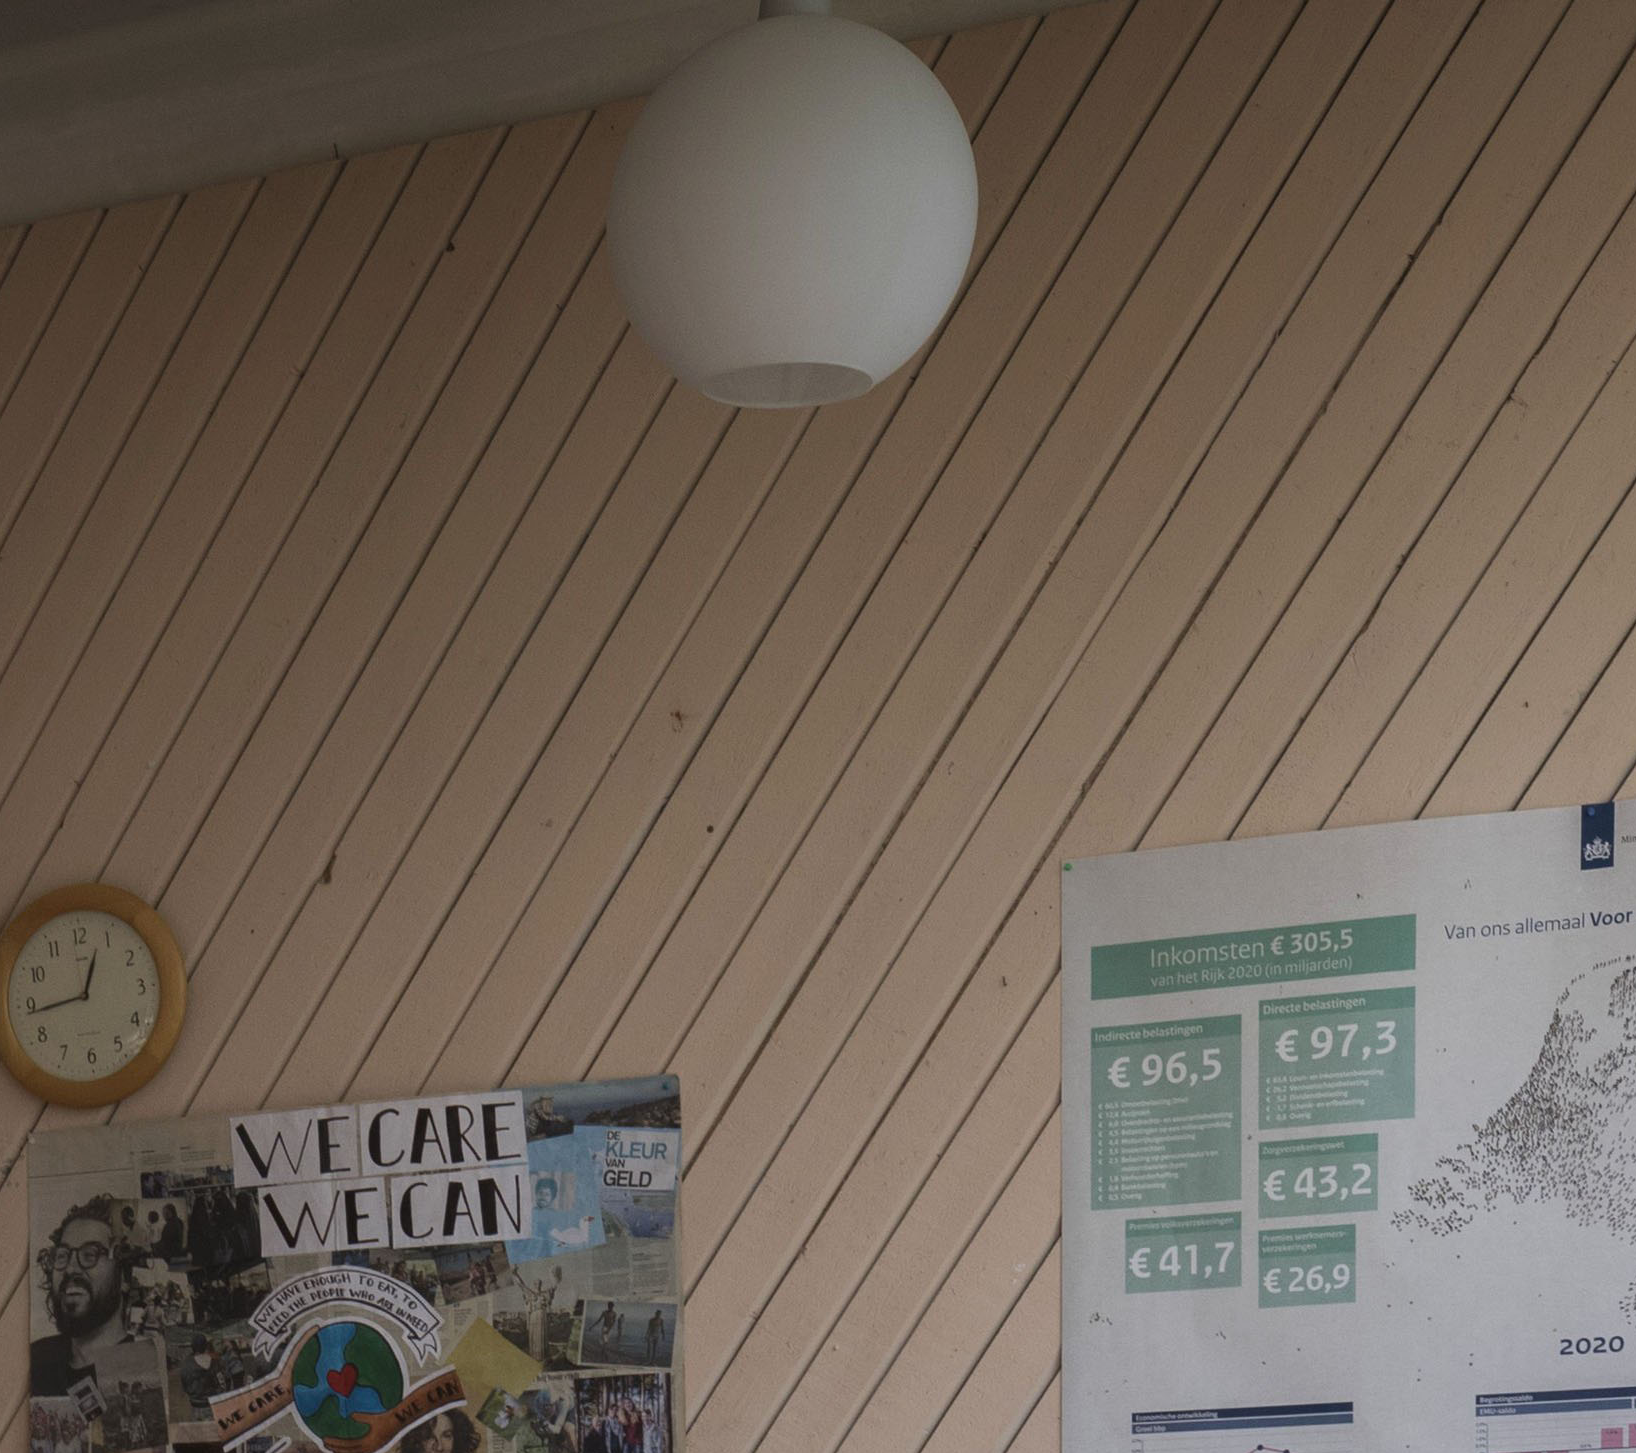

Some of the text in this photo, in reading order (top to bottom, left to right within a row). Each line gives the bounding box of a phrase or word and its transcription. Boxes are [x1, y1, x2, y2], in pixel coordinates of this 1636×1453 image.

[1444, 924, 1476, 940] Van
[1480, 923, 1510, 938] ons
[1515, 914, 1585, 935] allemaal
[1590, 910, 1632, 926] Voor
[73, 928, 87, 945] 12
[105, 931, 110, 948] 1
[49, 941, 59, 957] 11
[1150, 928, 1354, 968] Inkomsten € 305,5
[126, 951, 134, 967] 2
[31, 966, 45, 983] 10
[1151, 956, 1353, 988] van het Rijk 2020 (in miljarden)
[138, 979, 146, 995] 3
[26, 997, 35, 1014] 9
[1262, 996, 1366, 1016] Directe belastingen
[131, 1012, 140, 1027] 4
[37, 1027, 47, 1042] 8
[1094, 1023, 1203, 1042] Indirecte belastingen
[1275, 1021, 1397, 1062] € 97,3
[60, 1045, 68, 1060] 7
[114, 1037, 123, 1053] 5
[87, 1049, 96, 1064] 6
[1108, 1048, 1222, 1088] € 96,5
[234, 1101, 522, 1179] WE CARE
[607, 1131, 621, 1140] DE
[606, 1141, 667, 1159] KLEUR
[605, 1159, 625, 1168] VAN
[603, 1170, 652, 1187] GELD
[1263, 1164, 1372, 1200] € 43,2
[263, 1174, 522, 1249] WE CAN
[1129, 1242, 1234, 1278] € 41,7
[1263, 1264, 1350, 1293] € 26,9
[259, 1274, 418, 1323] WE HAVE ENOUGH TO EAT, TO
[289, 1297, 306, 1315] THE
[310, 1289, 345, 1301] PEOPLE
[350, 1289, 375, 1301] WHO
[377, 1297, 393, 1312] ARE
[406, 1312, 428, 1332] NEED
[1560, 1336, 1625, 1355] 2020
[394, 1381, 459, 1424] WE CAN
[218, 1408, 245, 1430] WE
